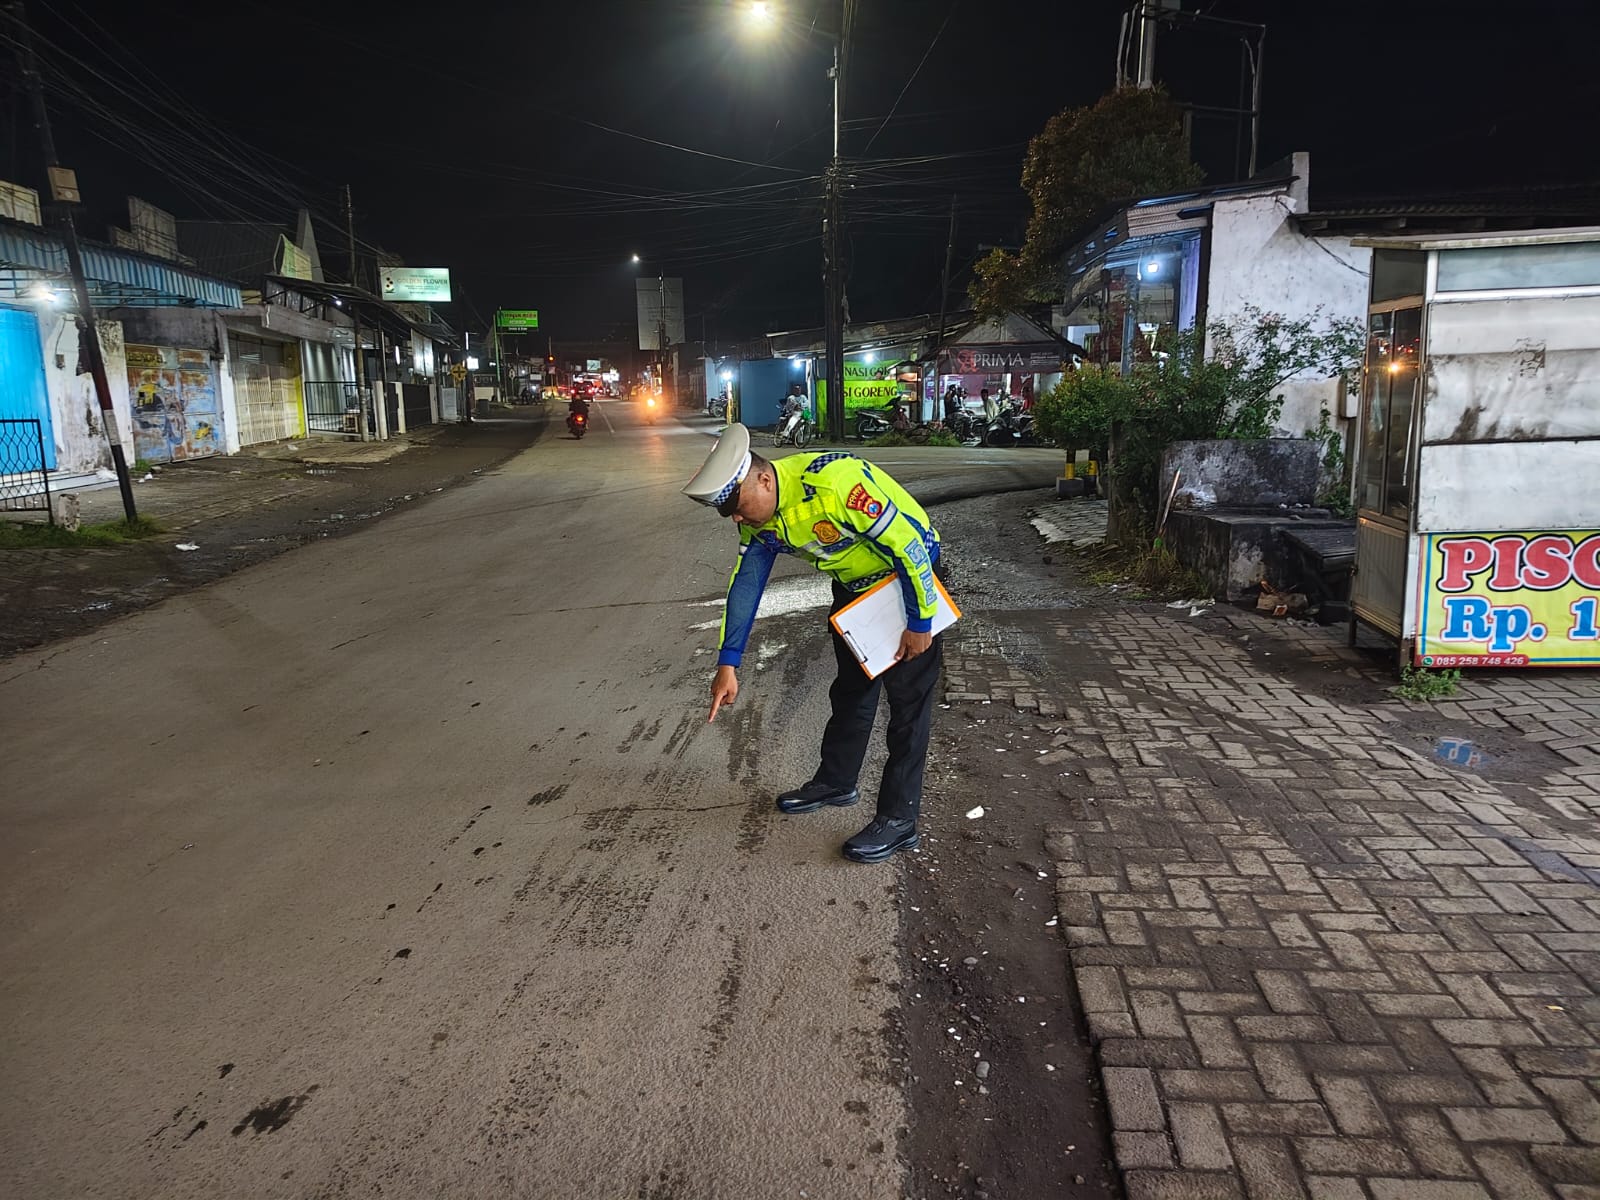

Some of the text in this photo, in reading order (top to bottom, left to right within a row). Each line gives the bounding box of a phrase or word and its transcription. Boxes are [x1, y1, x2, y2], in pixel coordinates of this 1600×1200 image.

[974, 353, 1024, 367] PRIMA
[845, 367, 868, 377] NASI
[854, 387, 897, 398] GORENG
[1442, 597, 1547, 653] Rp.
[1436, 656, 1524, 665] 085 258 748 426
